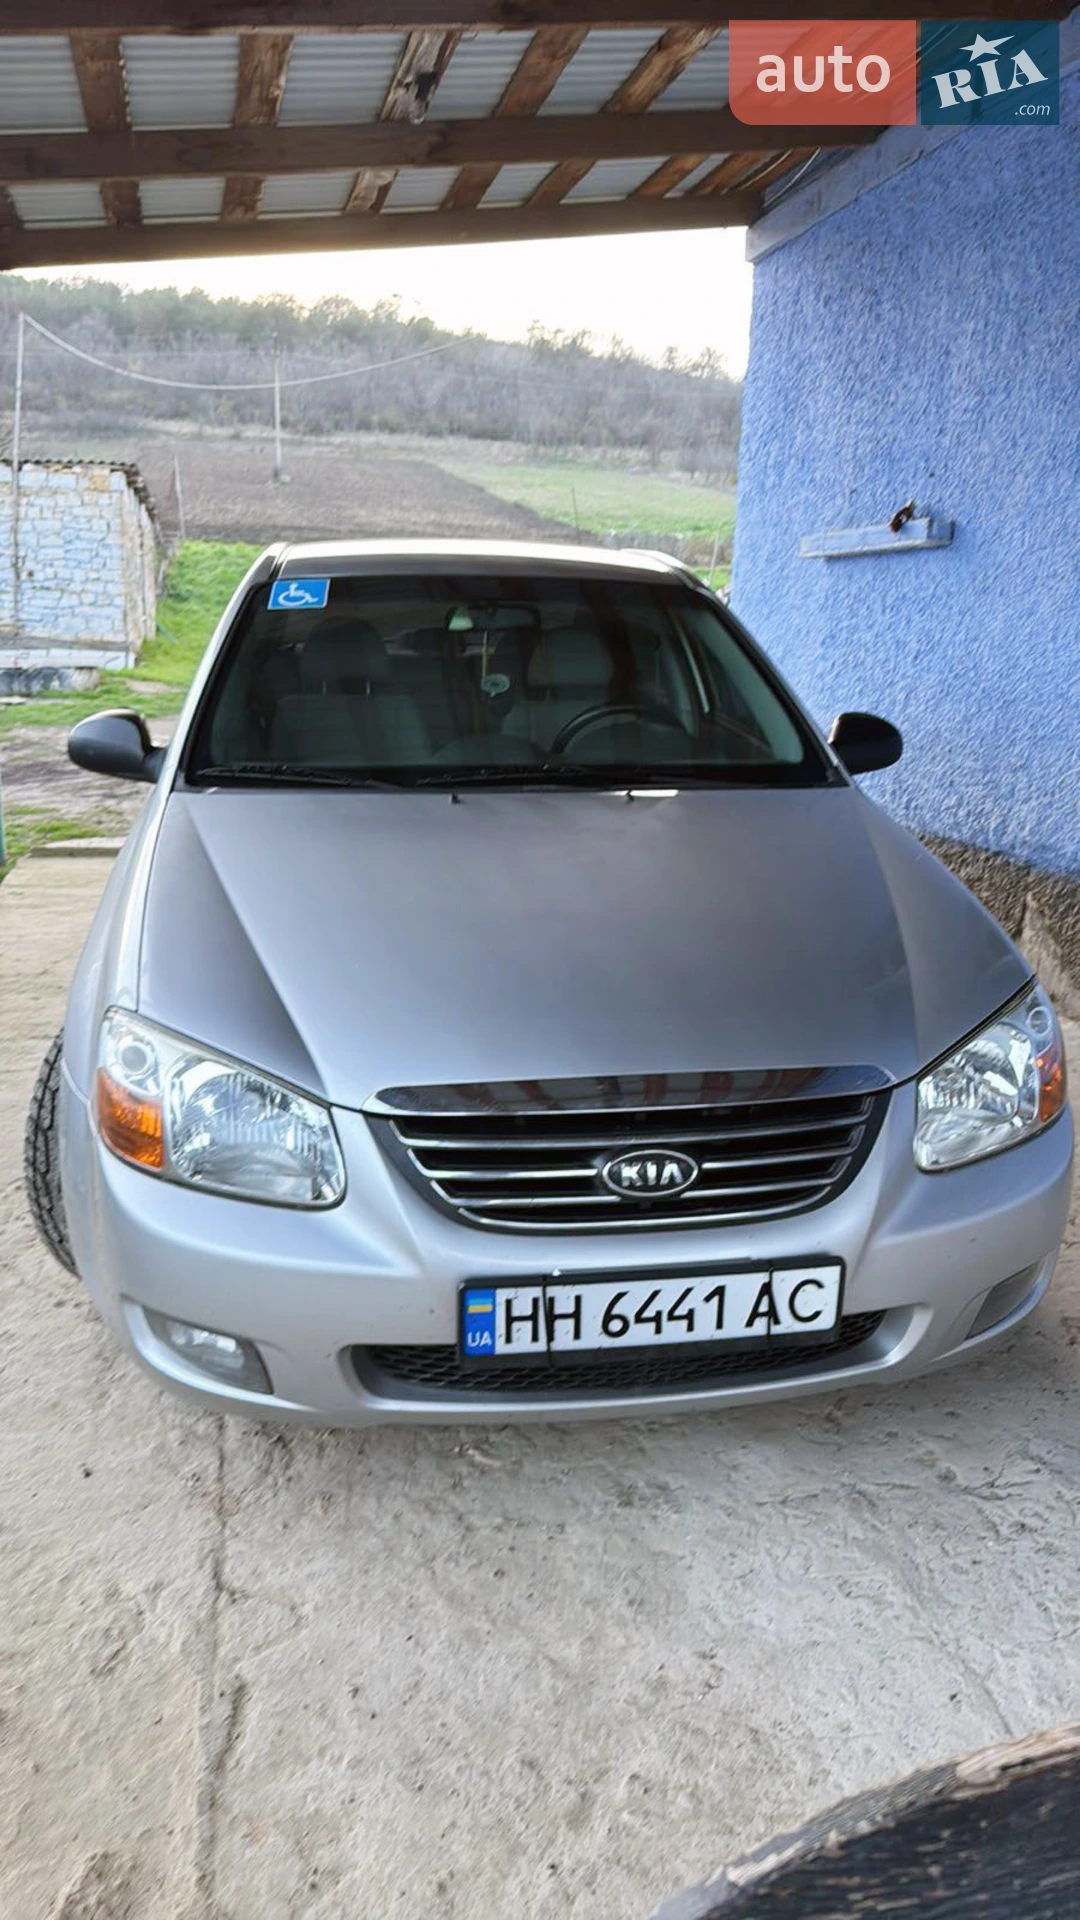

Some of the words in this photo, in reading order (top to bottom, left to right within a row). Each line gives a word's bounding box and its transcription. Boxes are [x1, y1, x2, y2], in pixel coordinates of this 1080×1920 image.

[620, 1161, 684, 1188] KIA
[504, 1294, 582, 1344] HH
[601, 1285, 726, 1339] 6441
[744, 1278, 825, 1329] AC
[467, 1329, 493, 1348] UA
